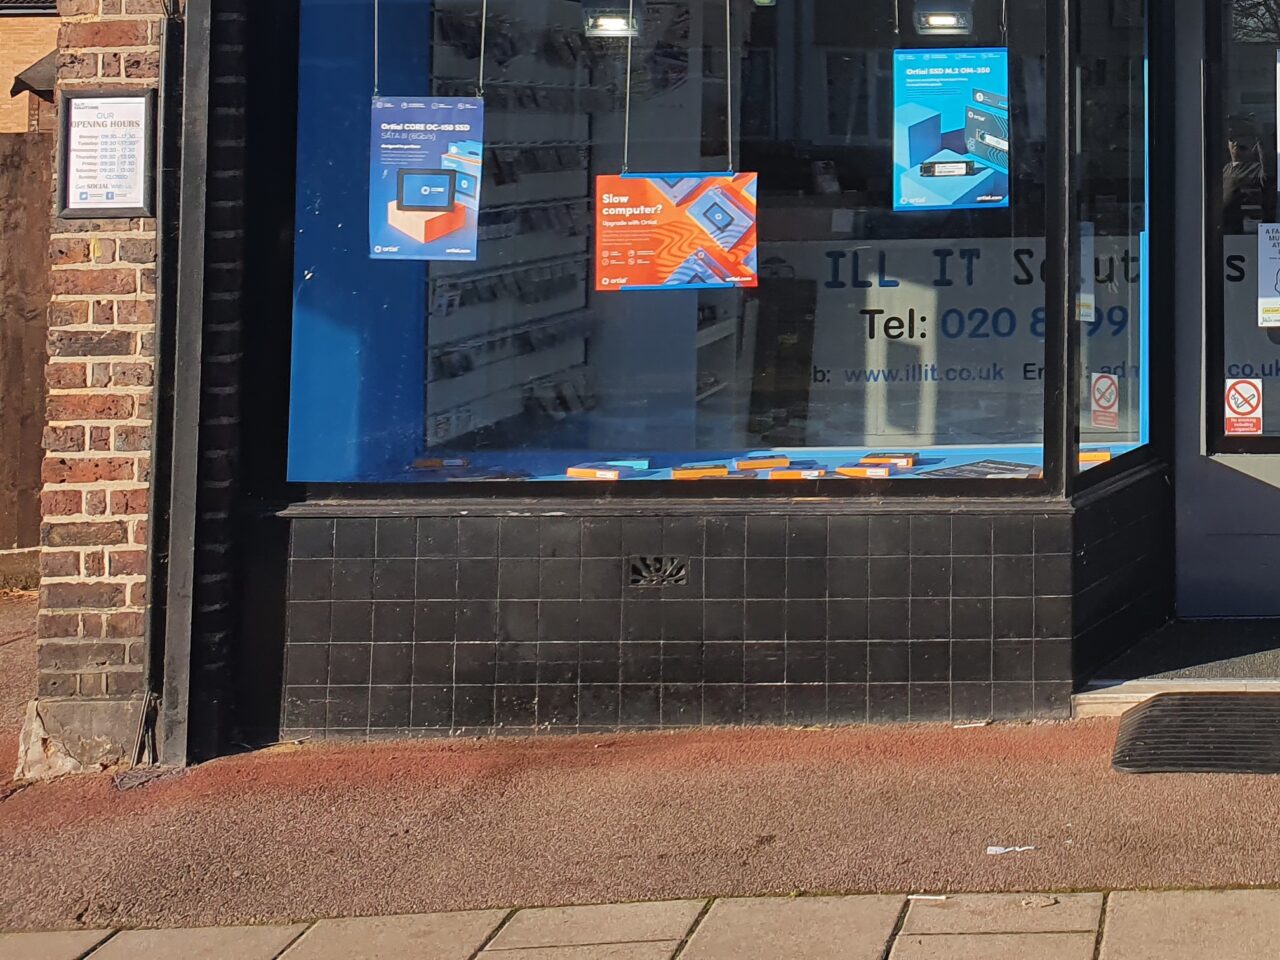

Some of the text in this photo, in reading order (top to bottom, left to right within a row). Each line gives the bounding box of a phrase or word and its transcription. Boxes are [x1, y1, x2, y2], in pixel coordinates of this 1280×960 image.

[602, 194, 629, 204] Slow
[602, 204, 663, 217] computer?
[824, 250, 900, 288] ILL
[932, 248, 981, 287] IT
[859, 308, 1016, 339] Tel: 020
[845, 362, 1004, 383] www.illit.co.uk
